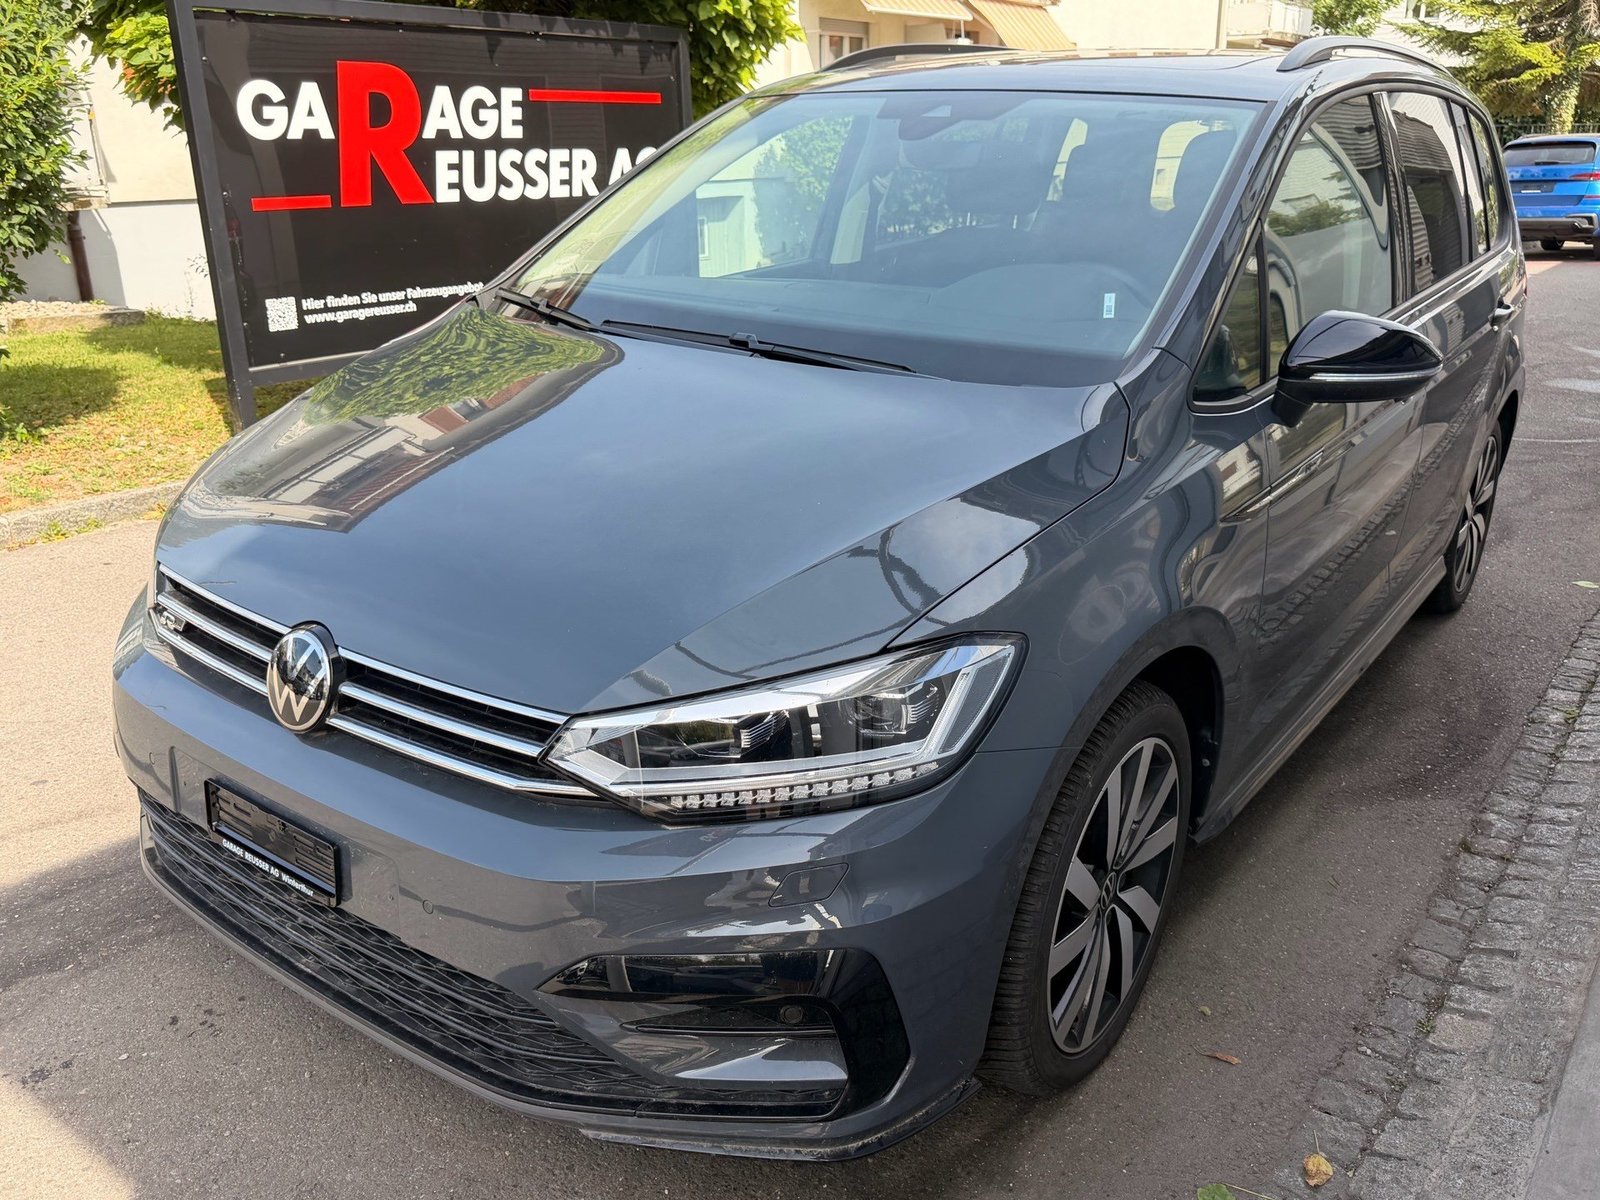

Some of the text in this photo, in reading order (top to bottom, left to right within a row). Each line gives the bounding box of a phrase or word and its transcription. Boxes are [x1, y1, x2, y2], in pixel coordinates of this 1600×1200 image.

[236, 61, 524, 207] GARAGE
[608, 146, 658, 186] A
[301, 281, 484, 310] Hier finden Sie unser Fahrzeugangebot
[304, 300, 417, 324] www.garagereusser.ch
[222, 838, 244, 858] GARAGE
[244, 851, 270, 873] REUSSER
[269, 866, 280, 878] AG
